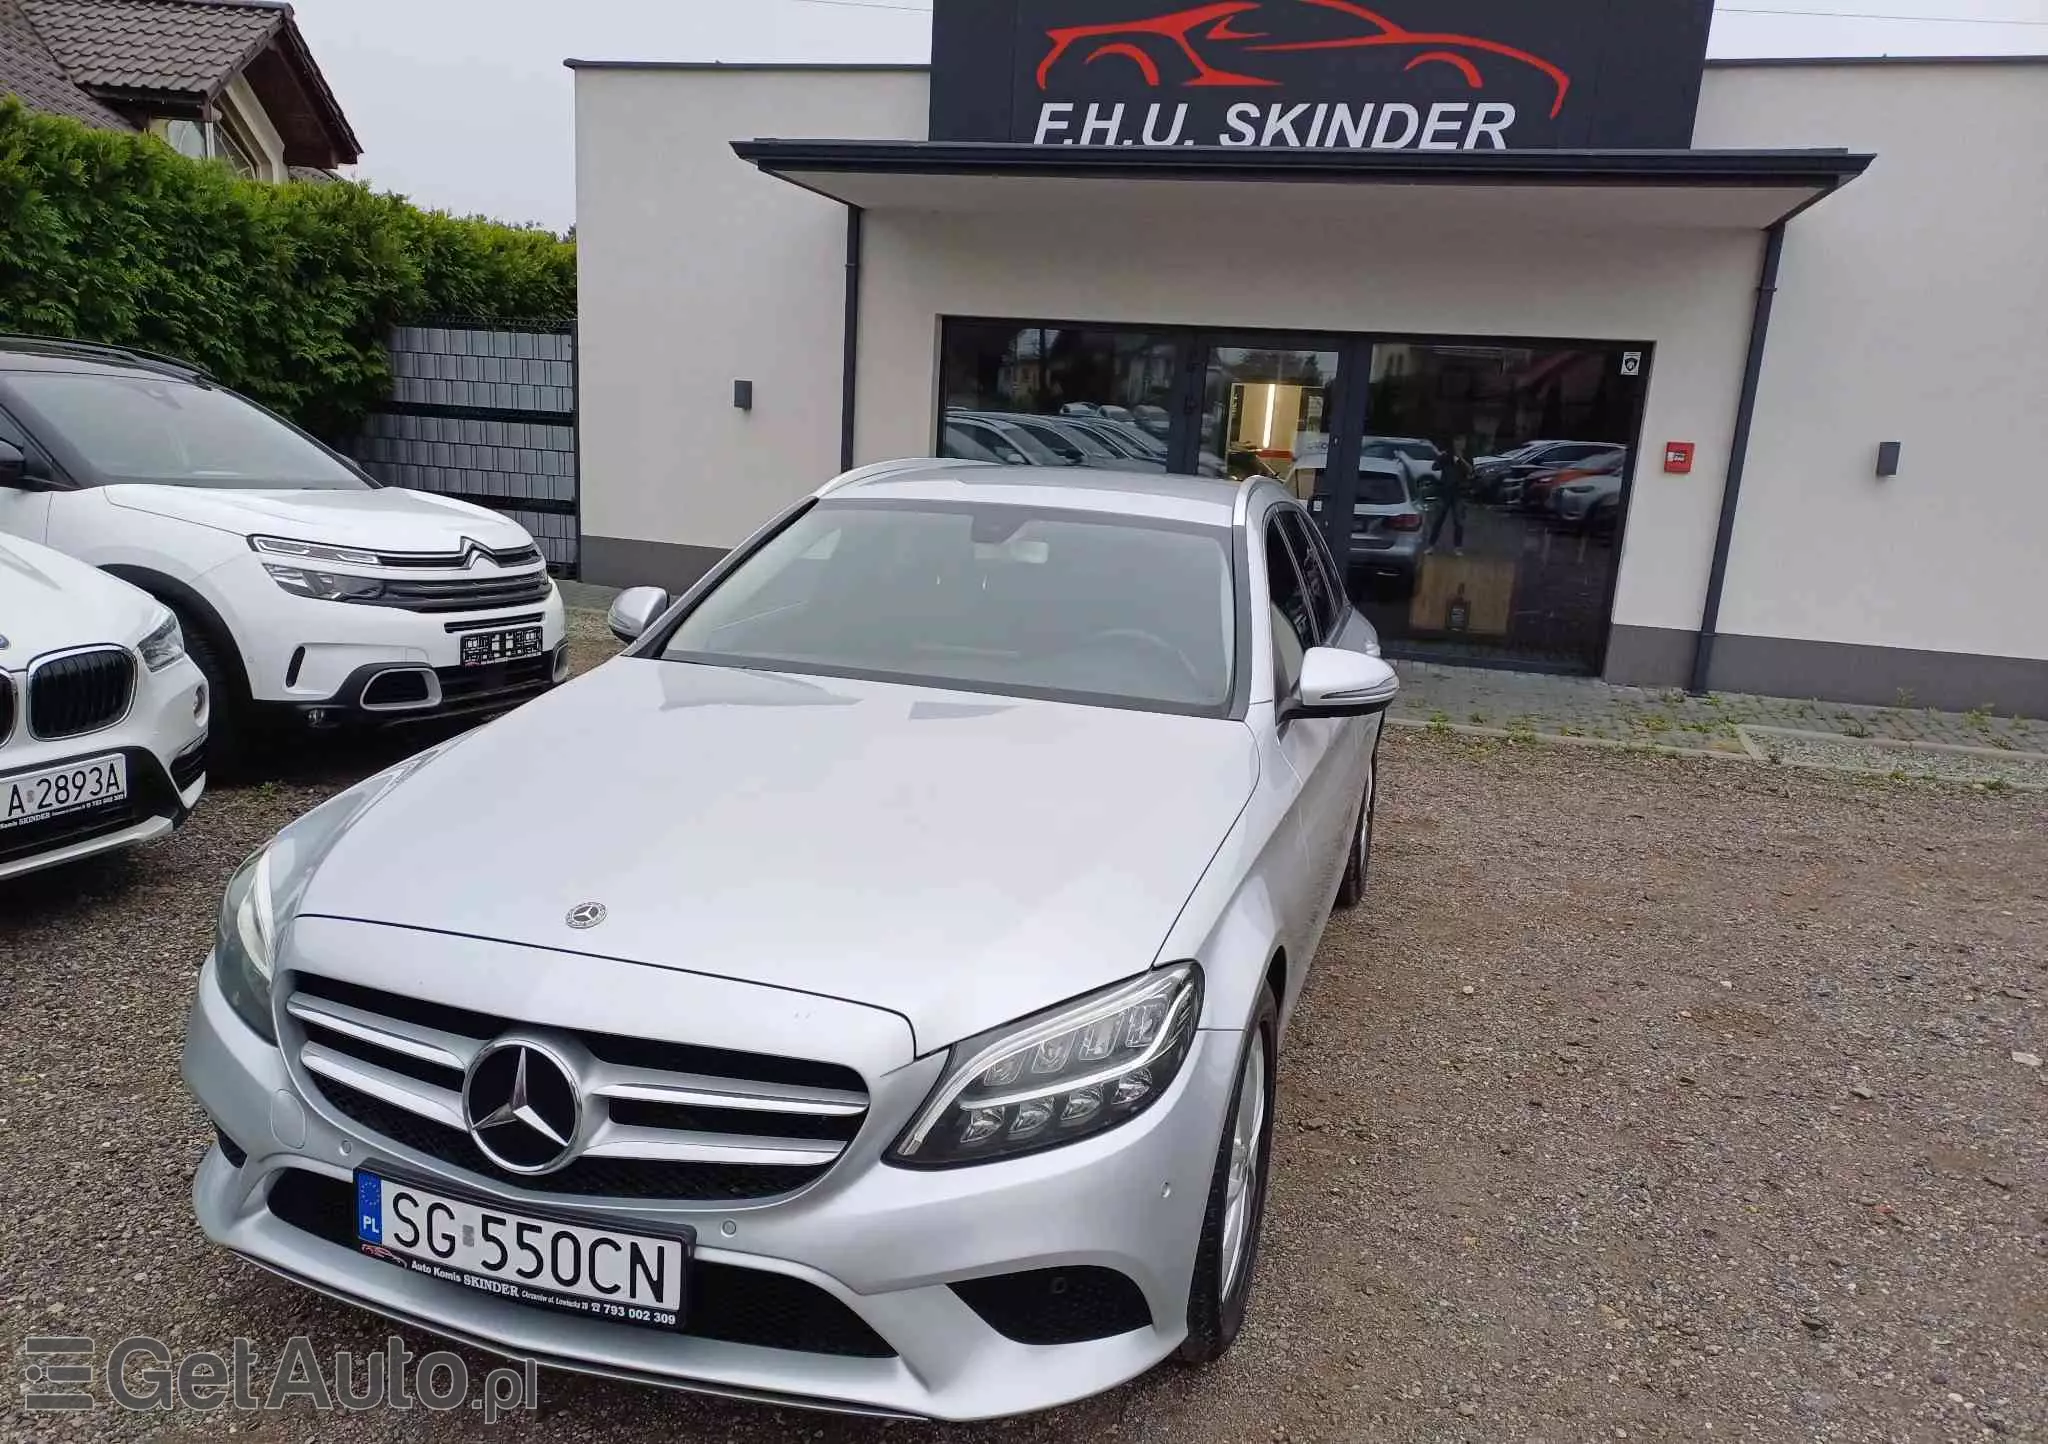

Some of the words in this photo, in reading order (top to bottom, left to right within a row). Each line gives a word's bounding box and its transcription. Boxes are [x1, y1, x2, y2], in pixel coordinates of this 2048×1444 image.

[1034, 102, 1194, 147] F.H.U.
[1219, 101, 1517, 150] SKINDER
[36, 763, 120, 810] 2893A
[363, 1215, 379, 1234] PL
[392, 1192, 456, 1259] SG
[480, 1213, 665, 1303] 550CN
[412, 1260, 431, 1274] Auto
[433, 1267, 462, 1282] Komis
[463, 1274, 519, 1297] SKINDER
[603, 1304, 625, 1317] 793
[629, 1308, 651, 1321] 002
[654, 1311, 676, 1325] 309
